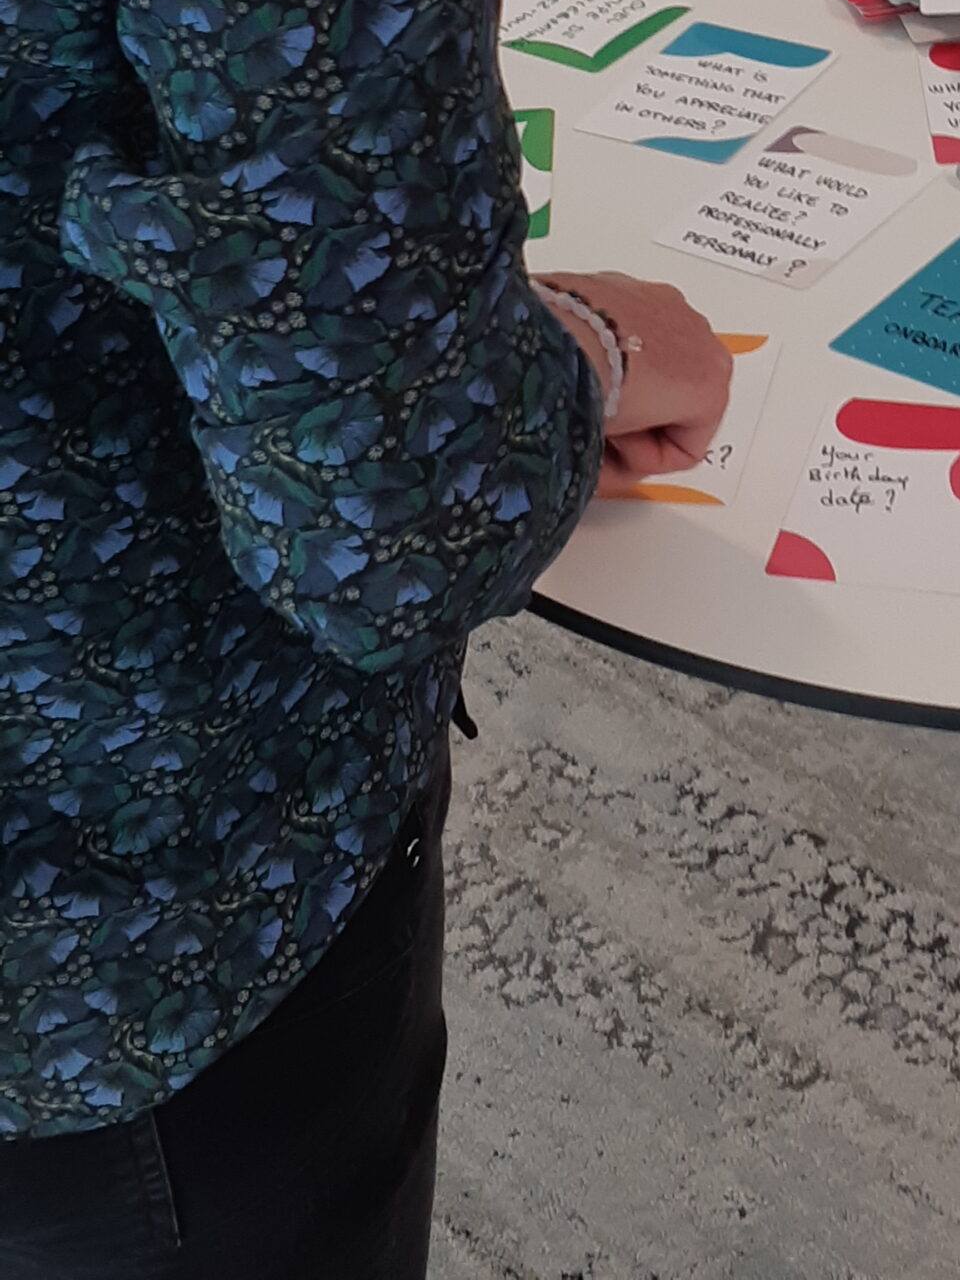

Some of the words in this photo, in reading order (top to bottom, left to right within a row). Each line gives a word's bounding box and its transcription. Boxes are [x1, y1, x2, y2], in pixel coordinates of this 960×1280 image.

[698, 60, 744, 76] WHAT
[636, 82, 665, 100] YOU
[743, 88, 786, 104] THAT
[758, 157, 811, 179] WHAT
[816, 175, 868, 199] WOULD
[744, 173, 769, 190] YOU
[830, 202, 849, 216] TO
